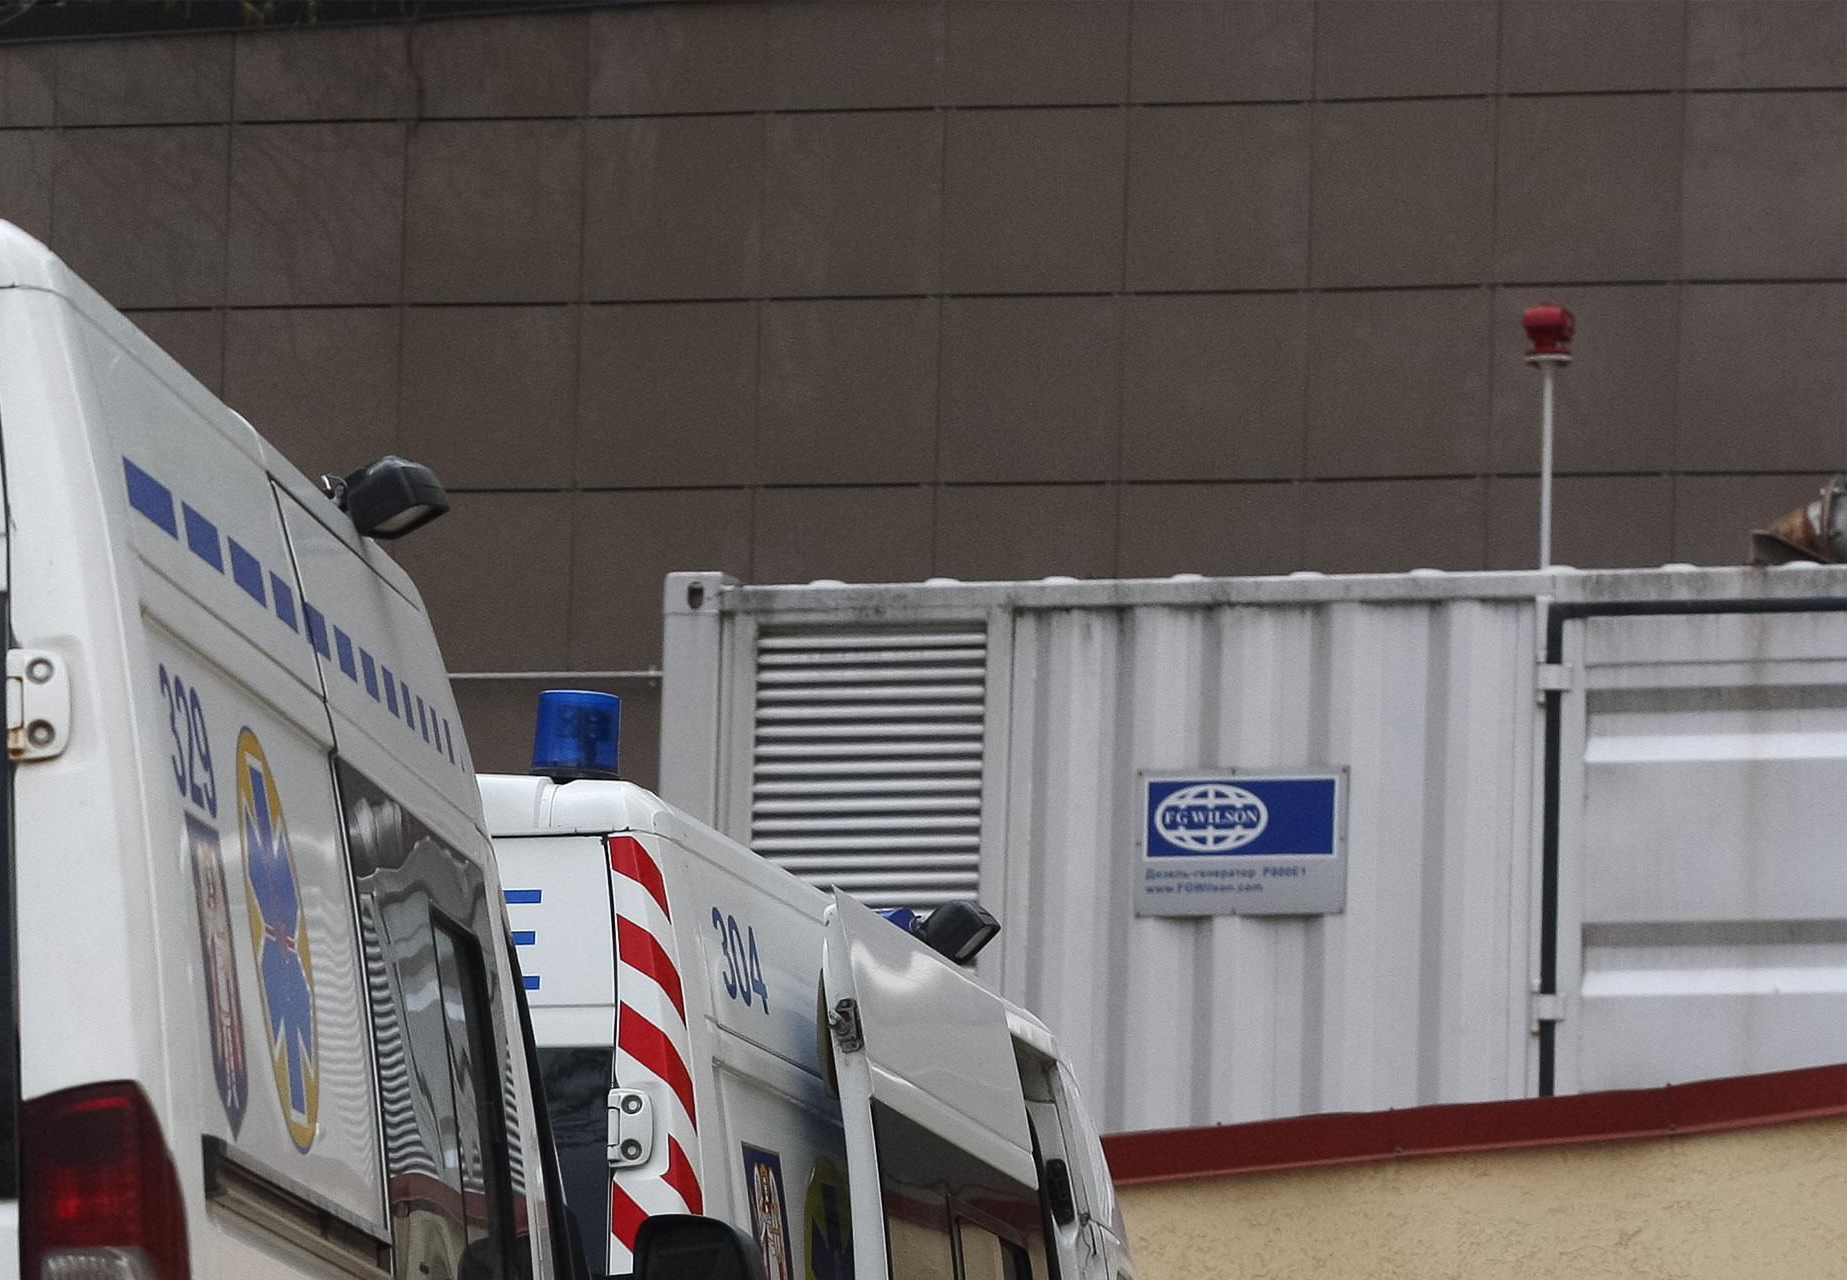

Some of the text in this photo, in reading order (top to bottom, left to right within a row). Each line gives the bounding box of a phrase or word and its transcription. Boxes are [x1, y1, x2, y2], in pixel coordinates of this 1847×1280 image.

[159, 662, 217, 819] 329
[1163, 808, 1259, 826] FG WILSON
[712, 906, 769, 1015] 304
